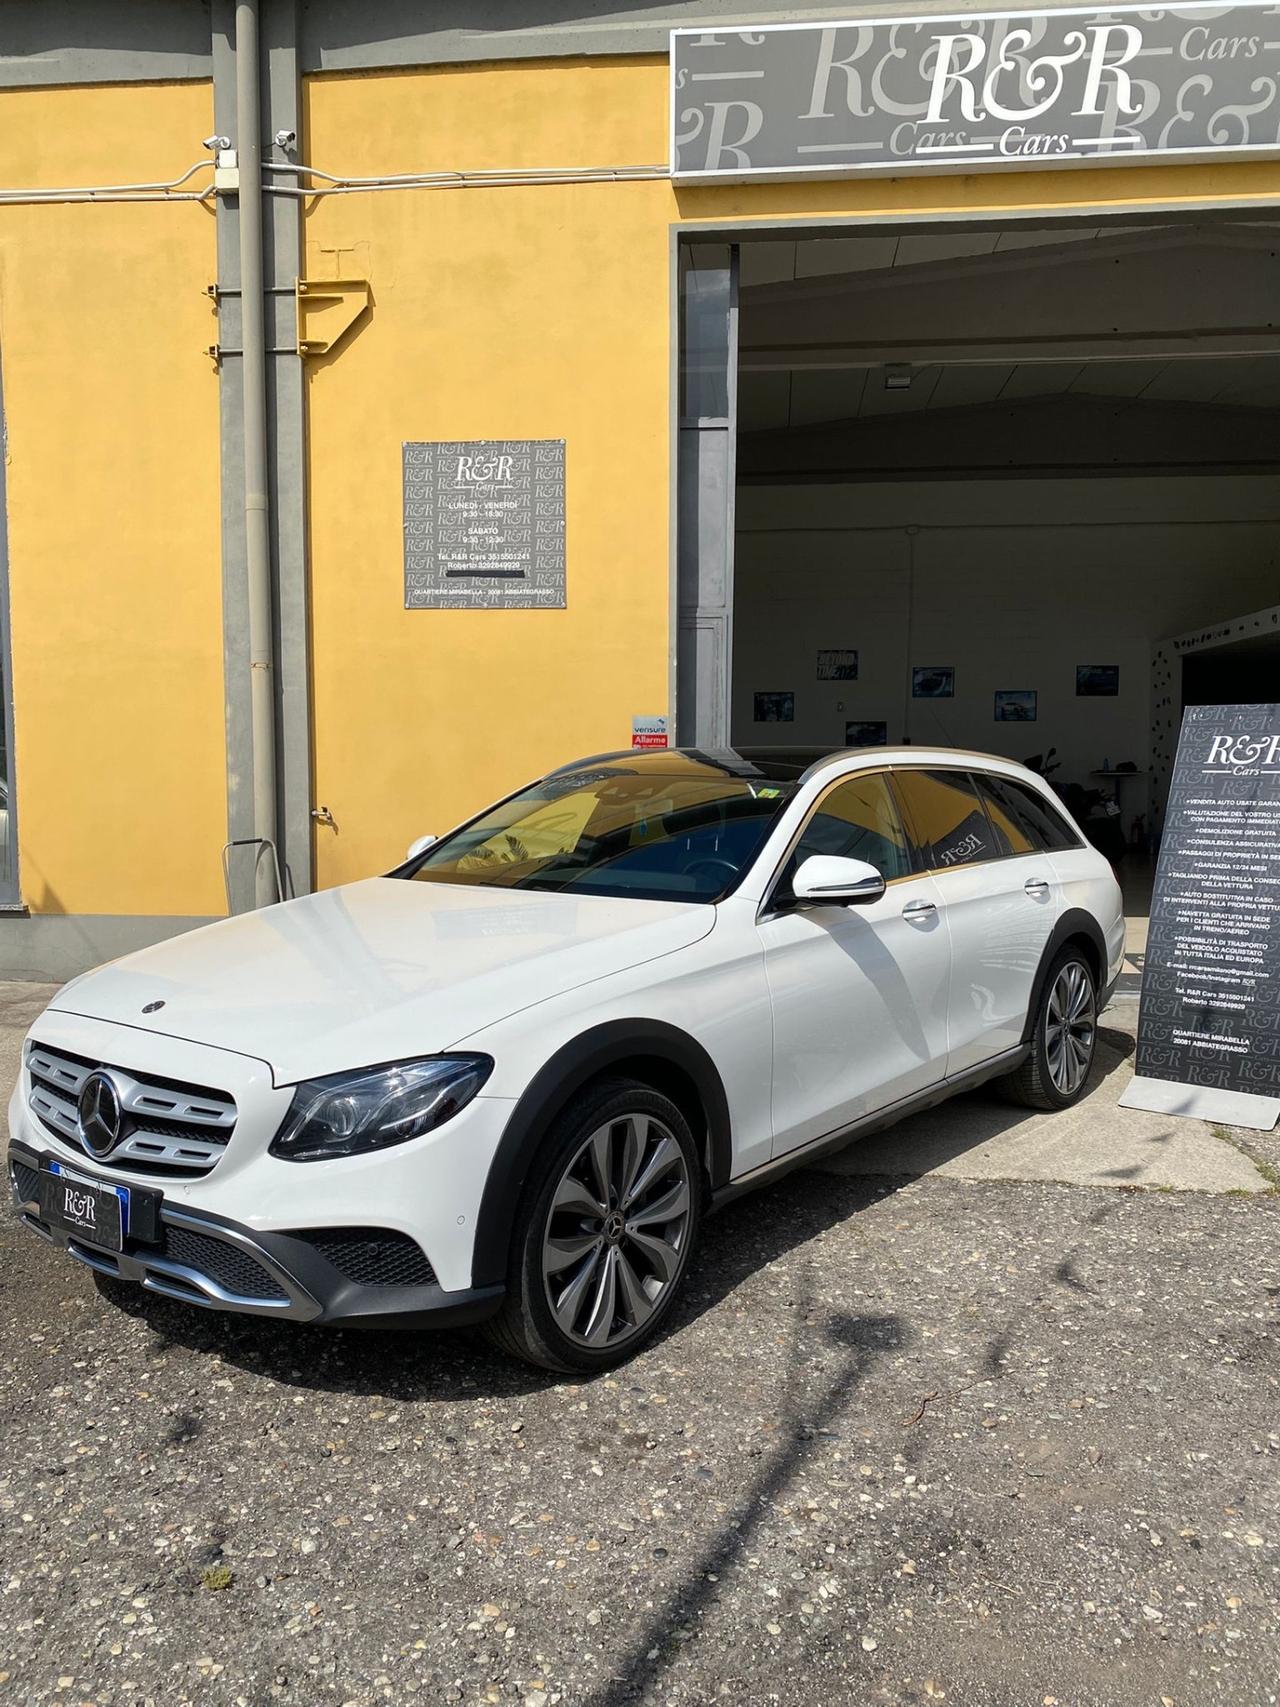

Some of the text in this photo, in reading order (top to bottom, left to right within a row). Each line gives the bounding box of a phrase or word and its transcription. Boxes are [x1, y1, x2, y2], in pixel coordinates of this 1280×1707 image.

[1180, 27, 1260, 61] Cars
[916, 25, 1142, 123] R&R
[1000, 126, 1069, 155] Cars
[455, 455, 513, 481] R&R
[475, 481, 496, 491] Cars
[468, 527, 498, 535] SABATO
[635, 736, 666, 744] Allarme
[1203, 735, 1280, 765] R&R
[1233, 766, 1260, 776] Cars
[1223, 882, 1253, 890] VETTURA
[1171, 897, 1208, 905] INTERVENTI
[1203, 893, 1245, 901] SOSTITUTIVA
[1202, 926, 1249, 935] TRENO/AEREO
[1227, 940, 1268, 949] TRASPORTO
[1191, 944, 1220, 952] VEICOLO
[1220, 947, 1262, 956] ACQUISTATO
[1204, 952, 1224, 960] ITALIA
[1236, 956, 1264, 964] EUROPA
[1202, 990, 1217, 998] Cars
[1183, 997, 1208, 1005] Roberto
[1172, 1029, 1250, 1045] QUARTIERE MIRABELLA
[1192, 1040, 1248, 1053] ABBIATEGRASSO
[63, 1187, 96, 1222] R&R
